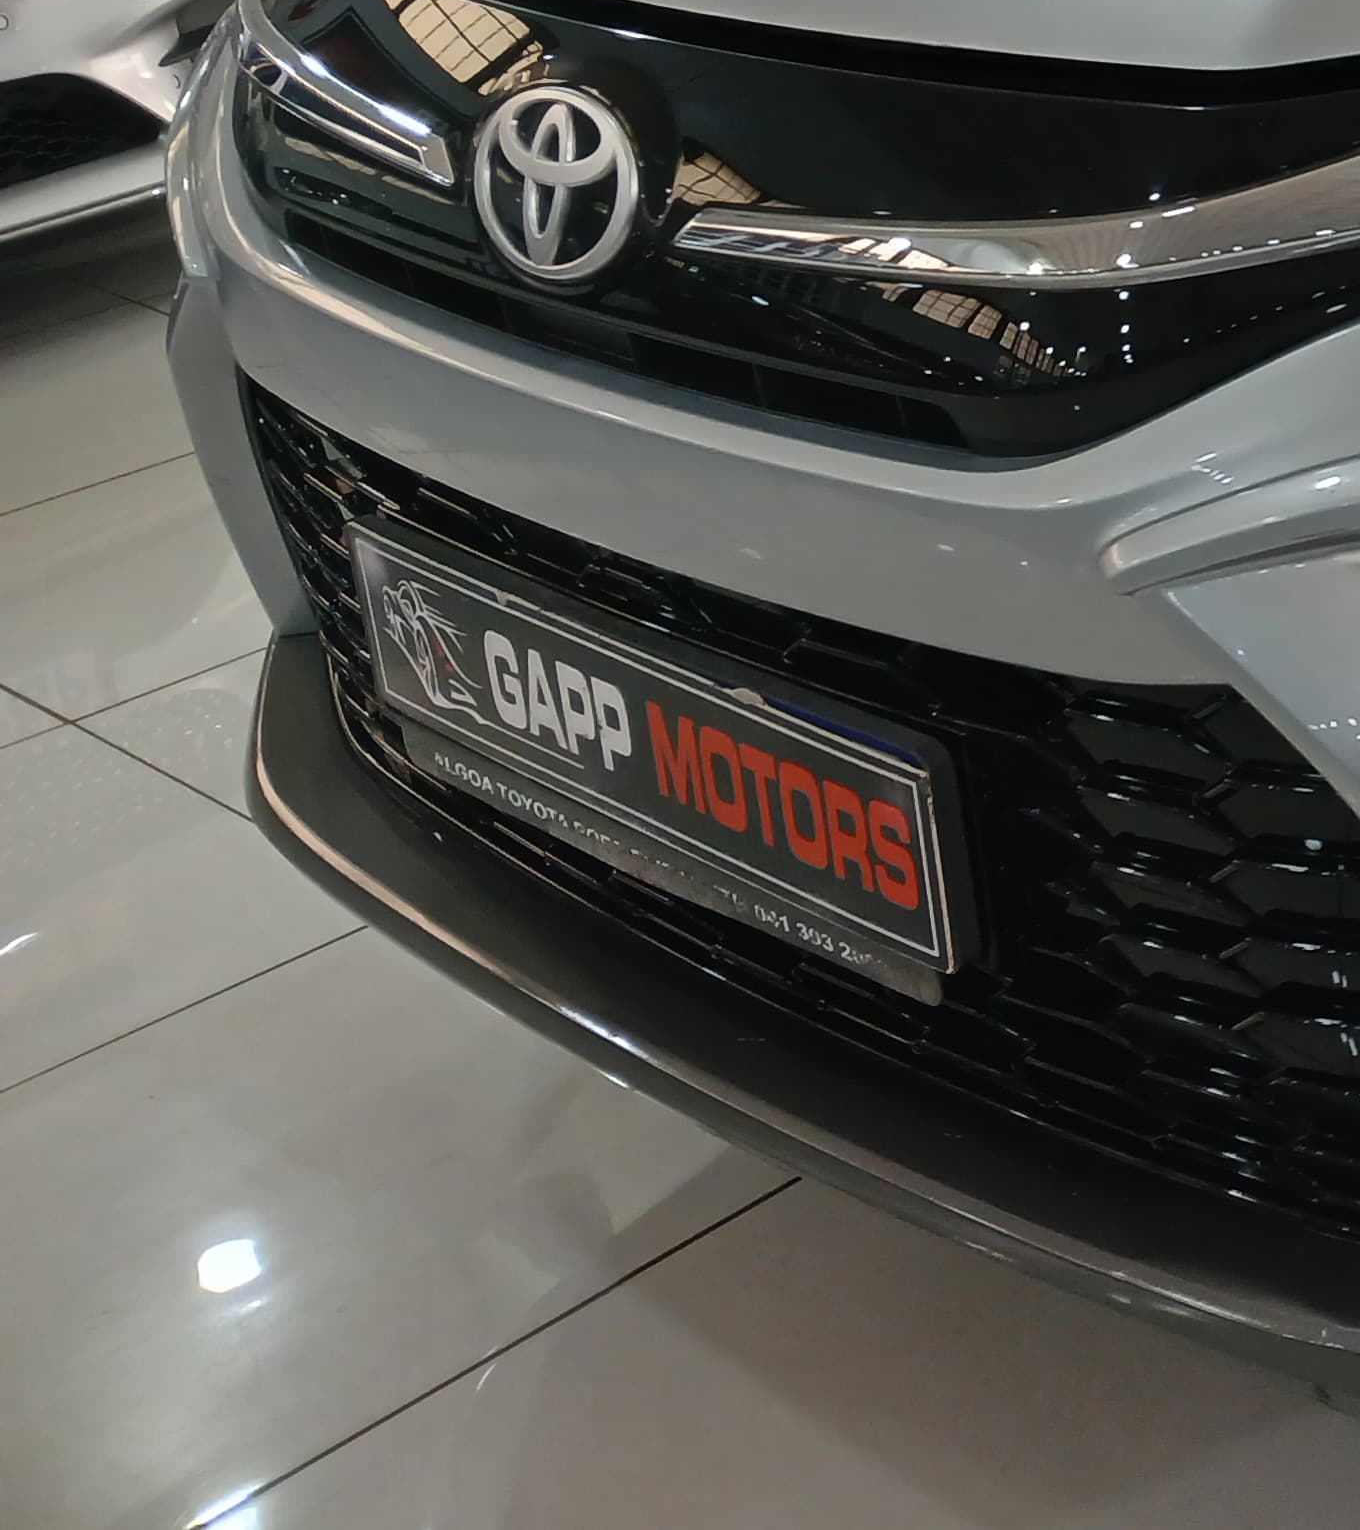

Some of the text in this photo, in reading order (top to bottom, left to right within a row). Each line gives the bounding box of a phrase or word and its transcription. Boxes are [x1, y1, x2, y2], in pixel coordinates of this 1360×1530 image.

[483, 630, 919, 911] GAPP MOTORS
[496, 781, 569, 828] TOYOTA
